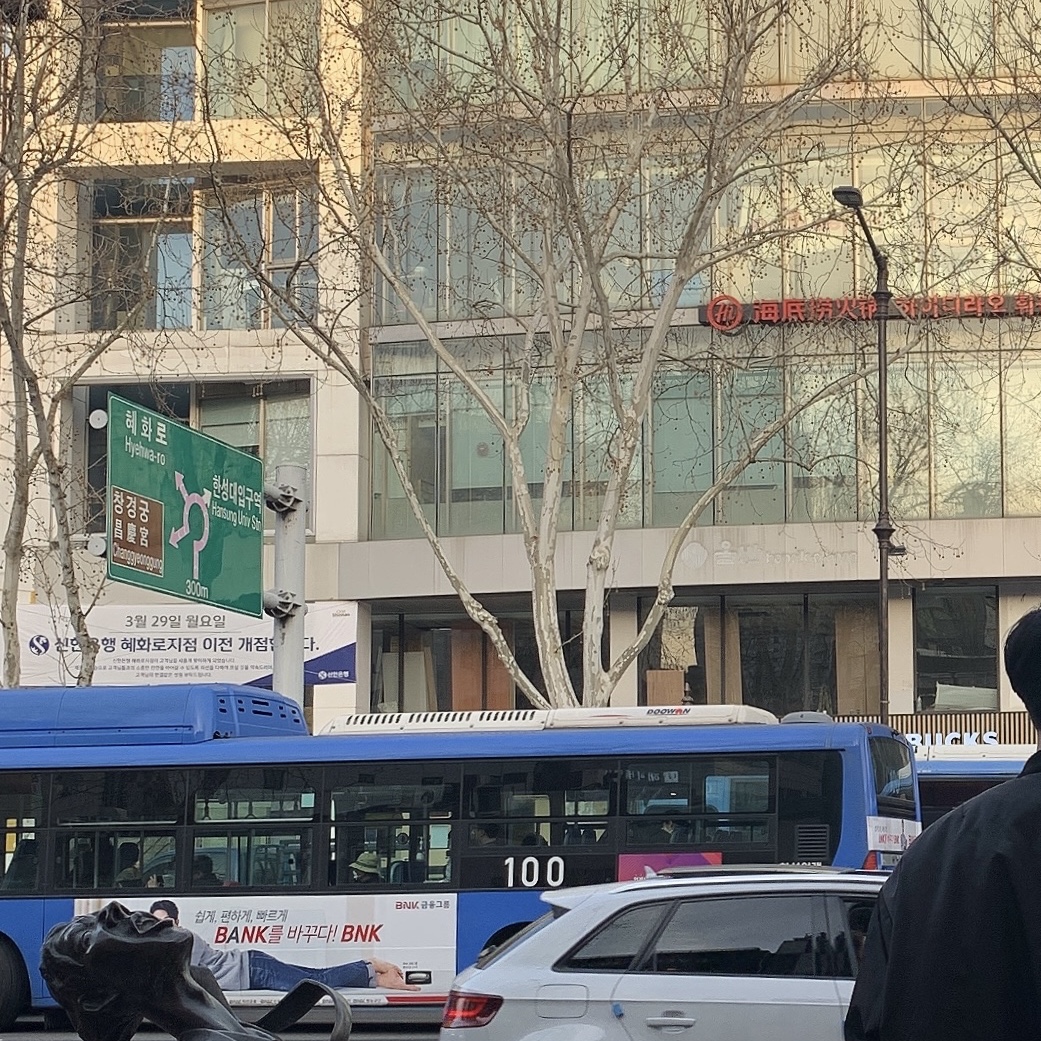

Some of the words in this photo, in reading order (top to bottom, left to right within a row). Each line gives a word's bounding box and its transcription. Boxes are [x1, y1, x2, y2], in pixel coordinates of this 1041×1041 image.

[896, 293, 1007, 318] 하이디라오
[125, 409, 168, 446] 혜화로
[124, 435, 166, 466] Hyehwa-ro
[113, 491, 150, 523] 창경궁
[212, 474, 262, 515] 한성대입구역
[211, 500, 238, 527] Hansung
[238, 509, 251, 528] Univ
[113, 518, 149, 548] 昌慶宮
[113, 541, 163, 574] Changgyeonggung
[185, 579, 209, 599] 300m
[125, 614, 147, 629] 3월
[151, 614, 181, 629] 29일
[186, 614, 226, 629] 월요일
[121, 636, 197, 653] 혜화로지점
[203, 636, 233, 653] 이전
[238, 636, 320, 653] 개점다.
[504, 856, 565, 888] 100
[195, 910, 217, 924] 쉽게,
[220, 909, 253, 923] 편하게,
[256, 909, 288, 923] 빠르게
[395, 901, 419, 910] BNK
[421, 900, 450, 910] 금융그룹
[214, 925, 284, 944] BANK를
[287, 924, 338, 944] 바꾸다!
[340, 924, 384, 943] BNK
